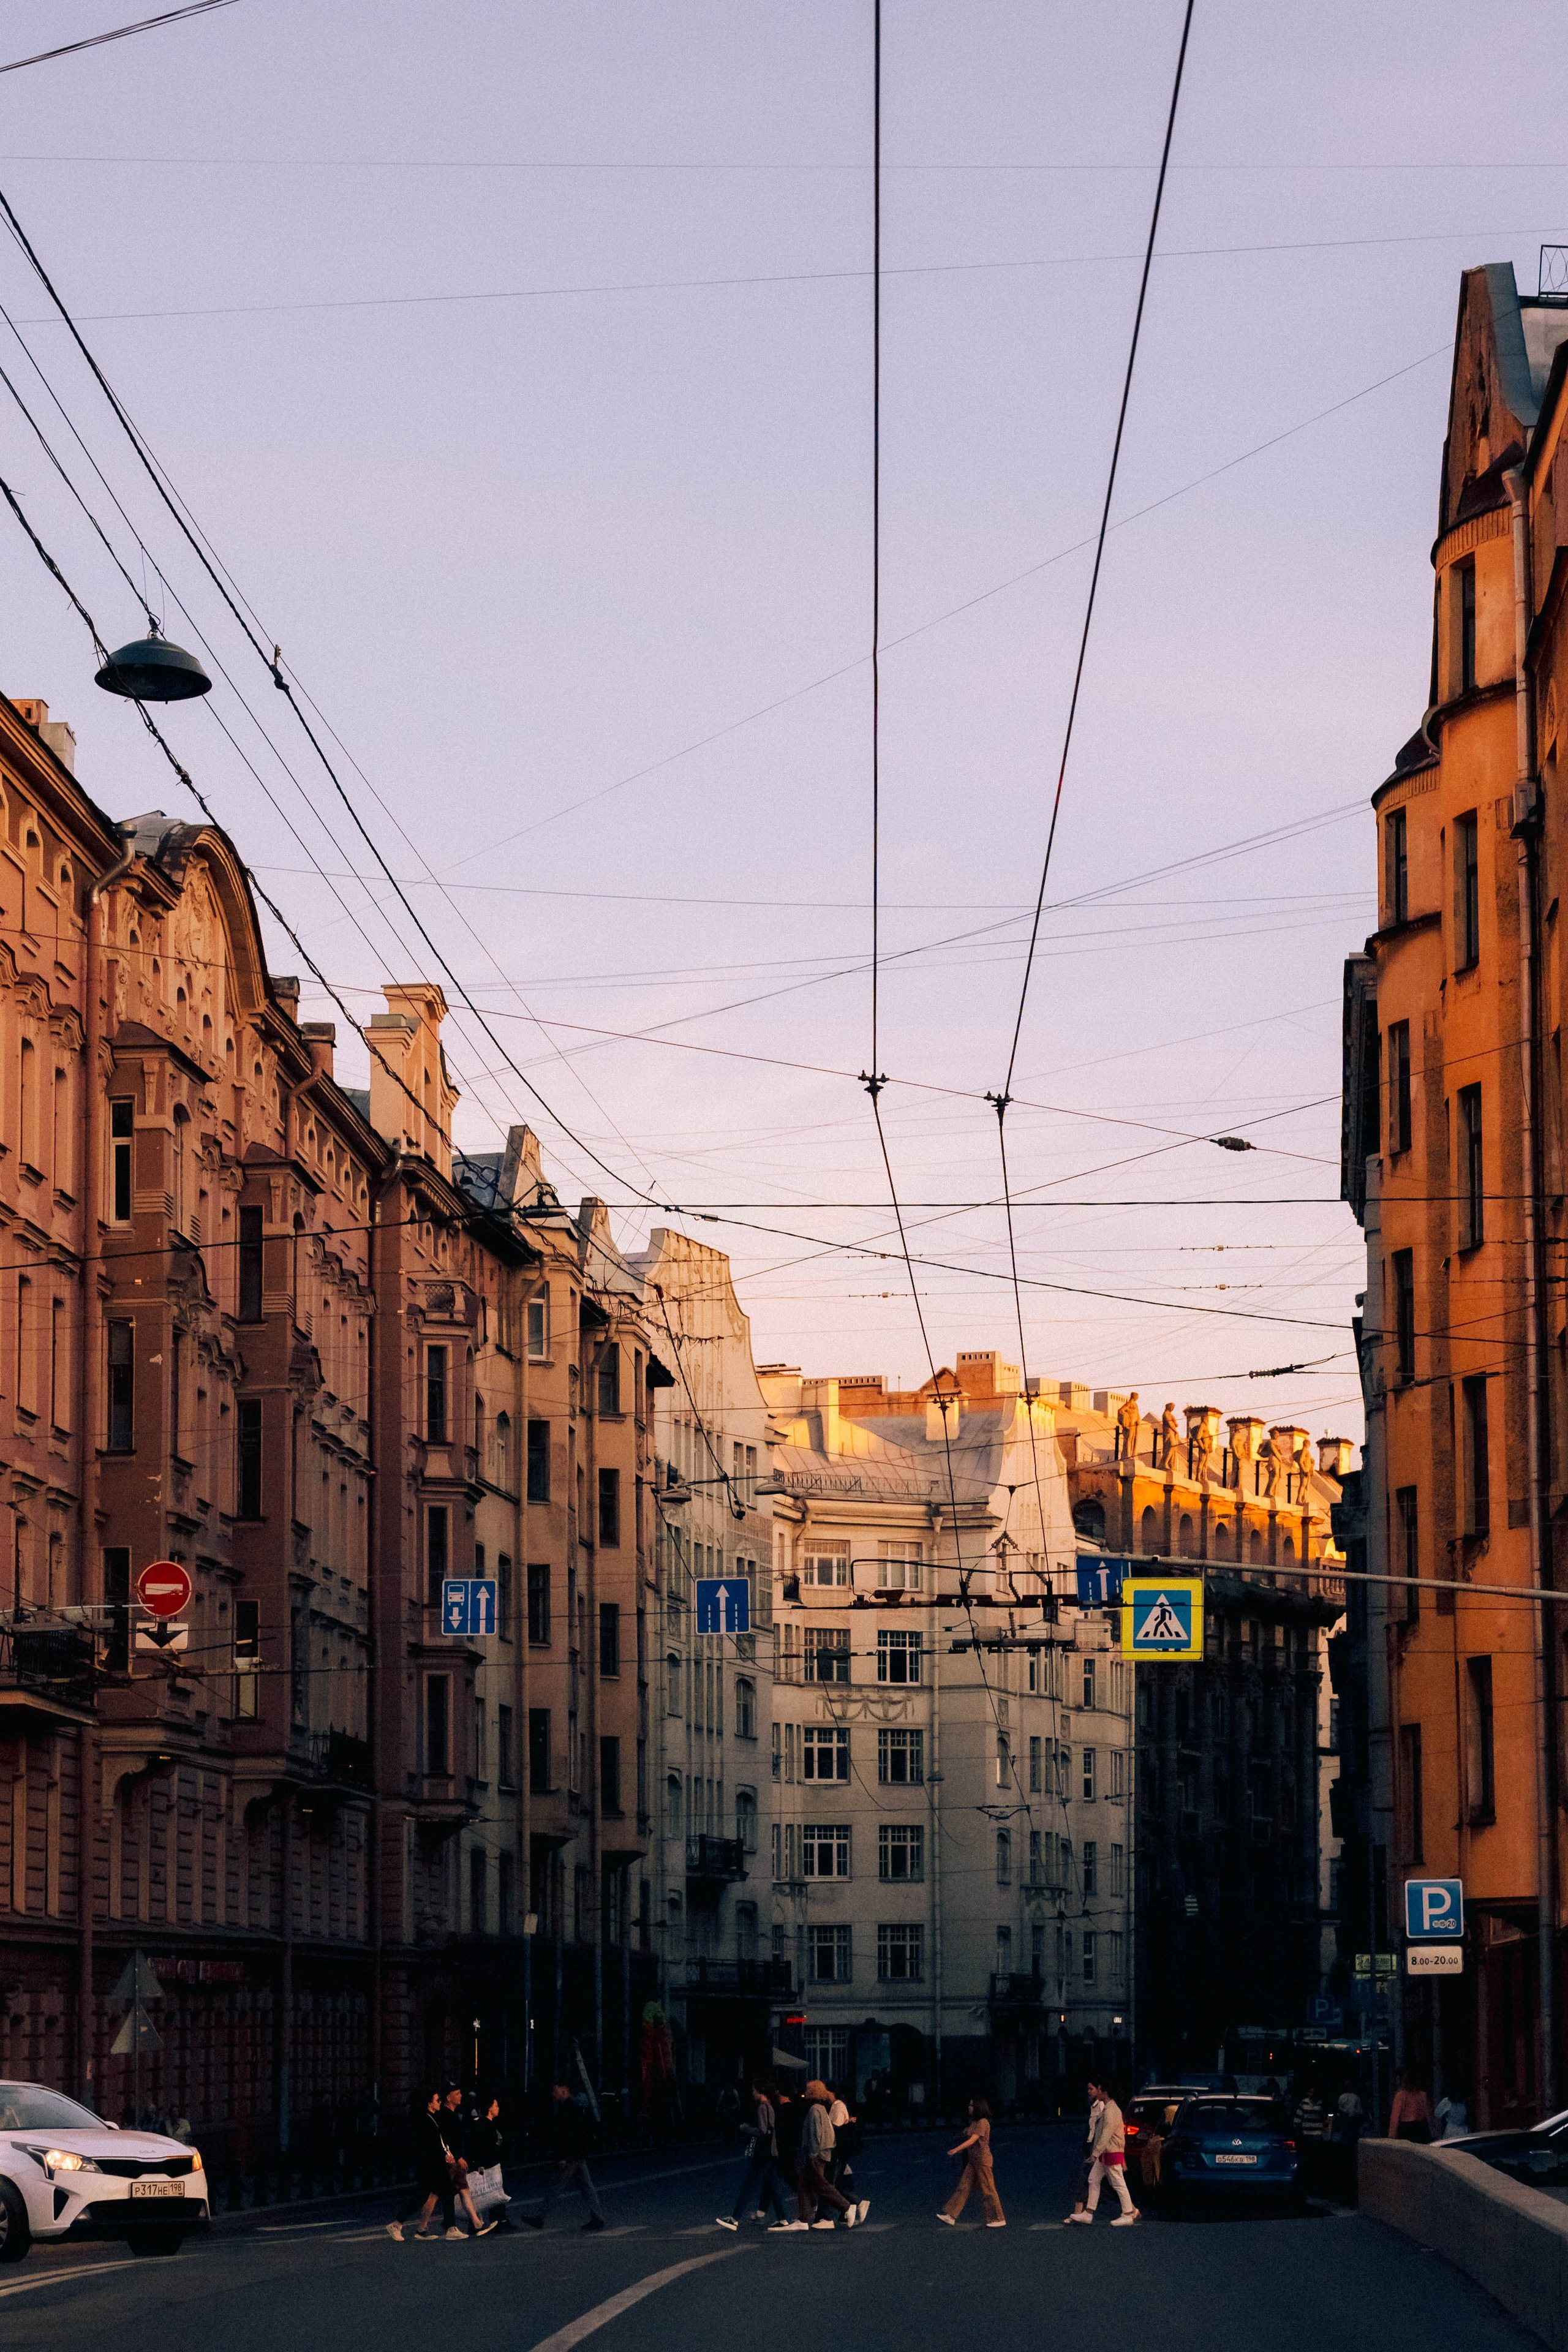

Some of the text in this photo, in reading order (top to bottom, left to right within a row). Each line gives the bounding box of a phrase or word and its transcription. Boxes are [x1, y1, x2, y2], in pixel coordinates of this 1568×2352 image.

[1422, 1887, 1451, 1930] P
[1411, 1956, 1458, 1966] 8.00-20.00
[170, 2183, 182, 2192] 198
